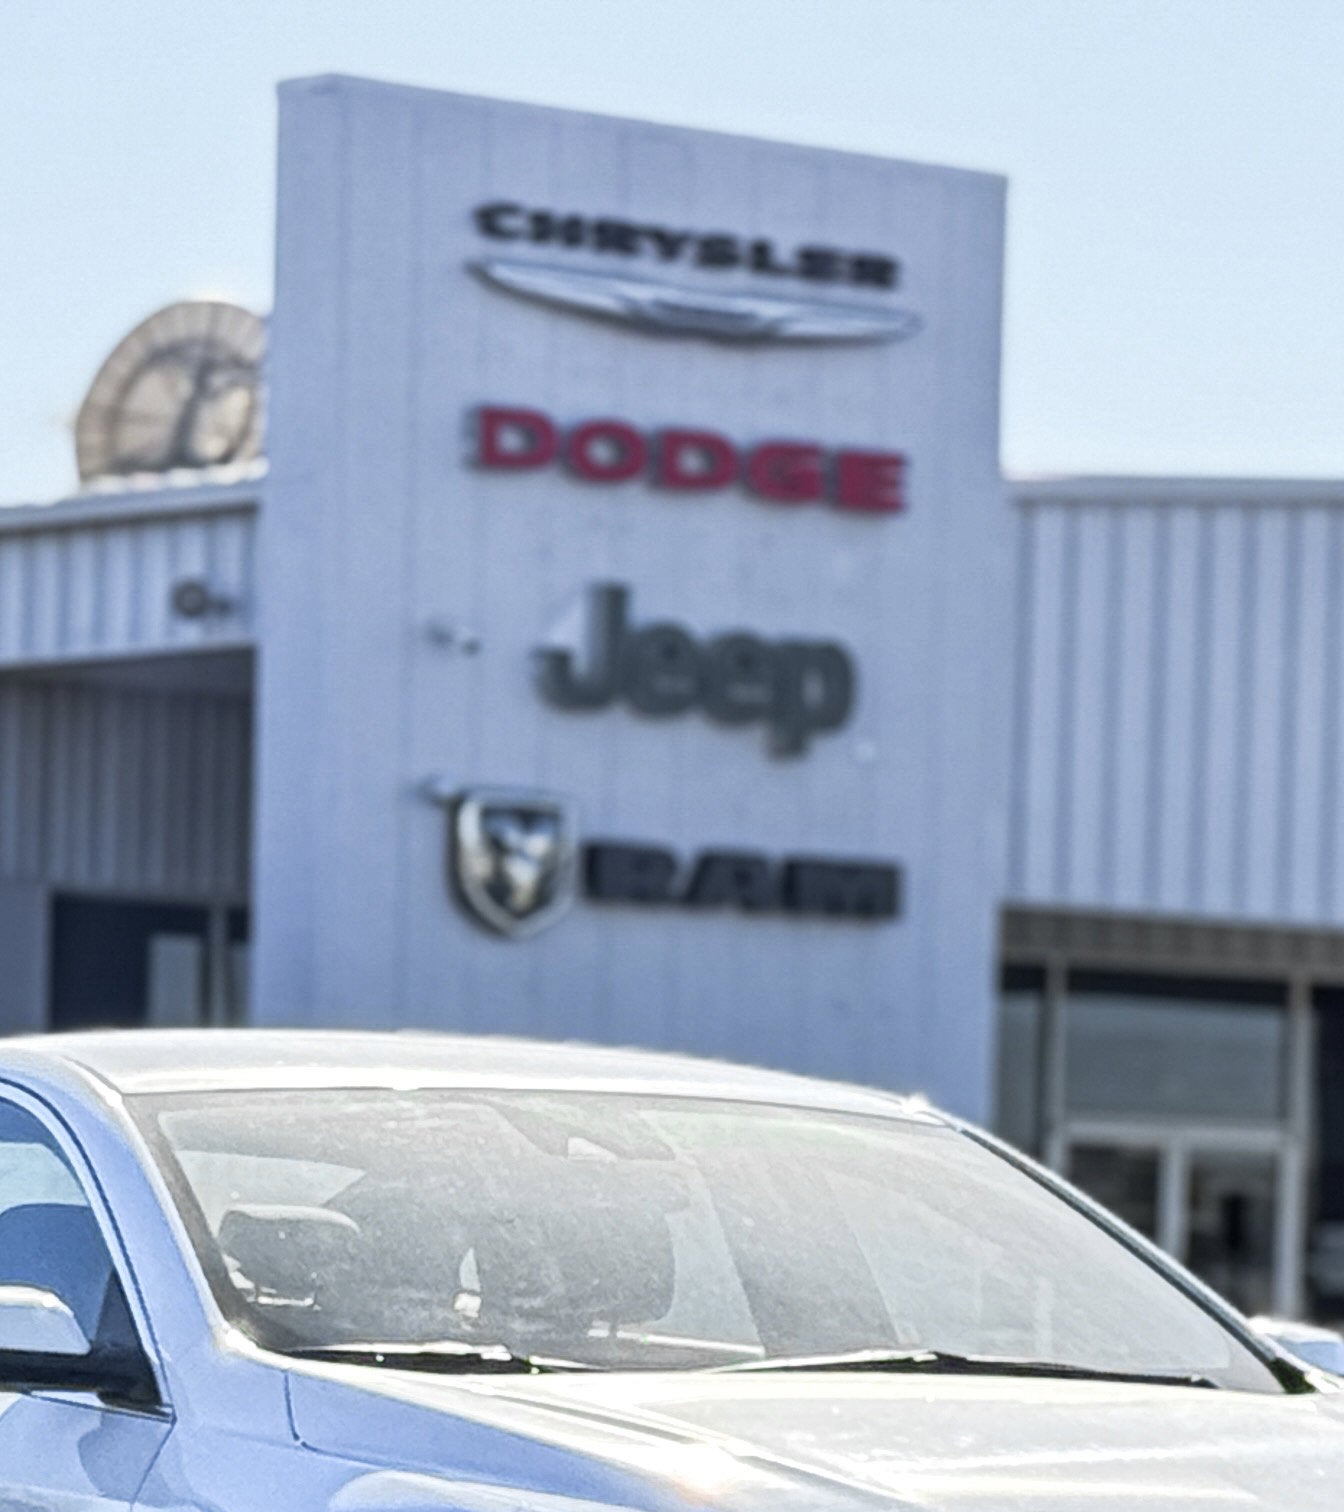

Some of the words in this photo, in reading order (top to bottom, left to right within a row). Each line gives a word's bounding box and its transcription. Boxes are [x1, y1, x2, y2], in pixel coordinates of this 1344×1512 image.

[473, 203, 900, 289] CHRYSLER
[472, 407, 910, 514] DODGE
[534, 582, 854, 760] Jeep
[581, 840, 902, 918] RAM
